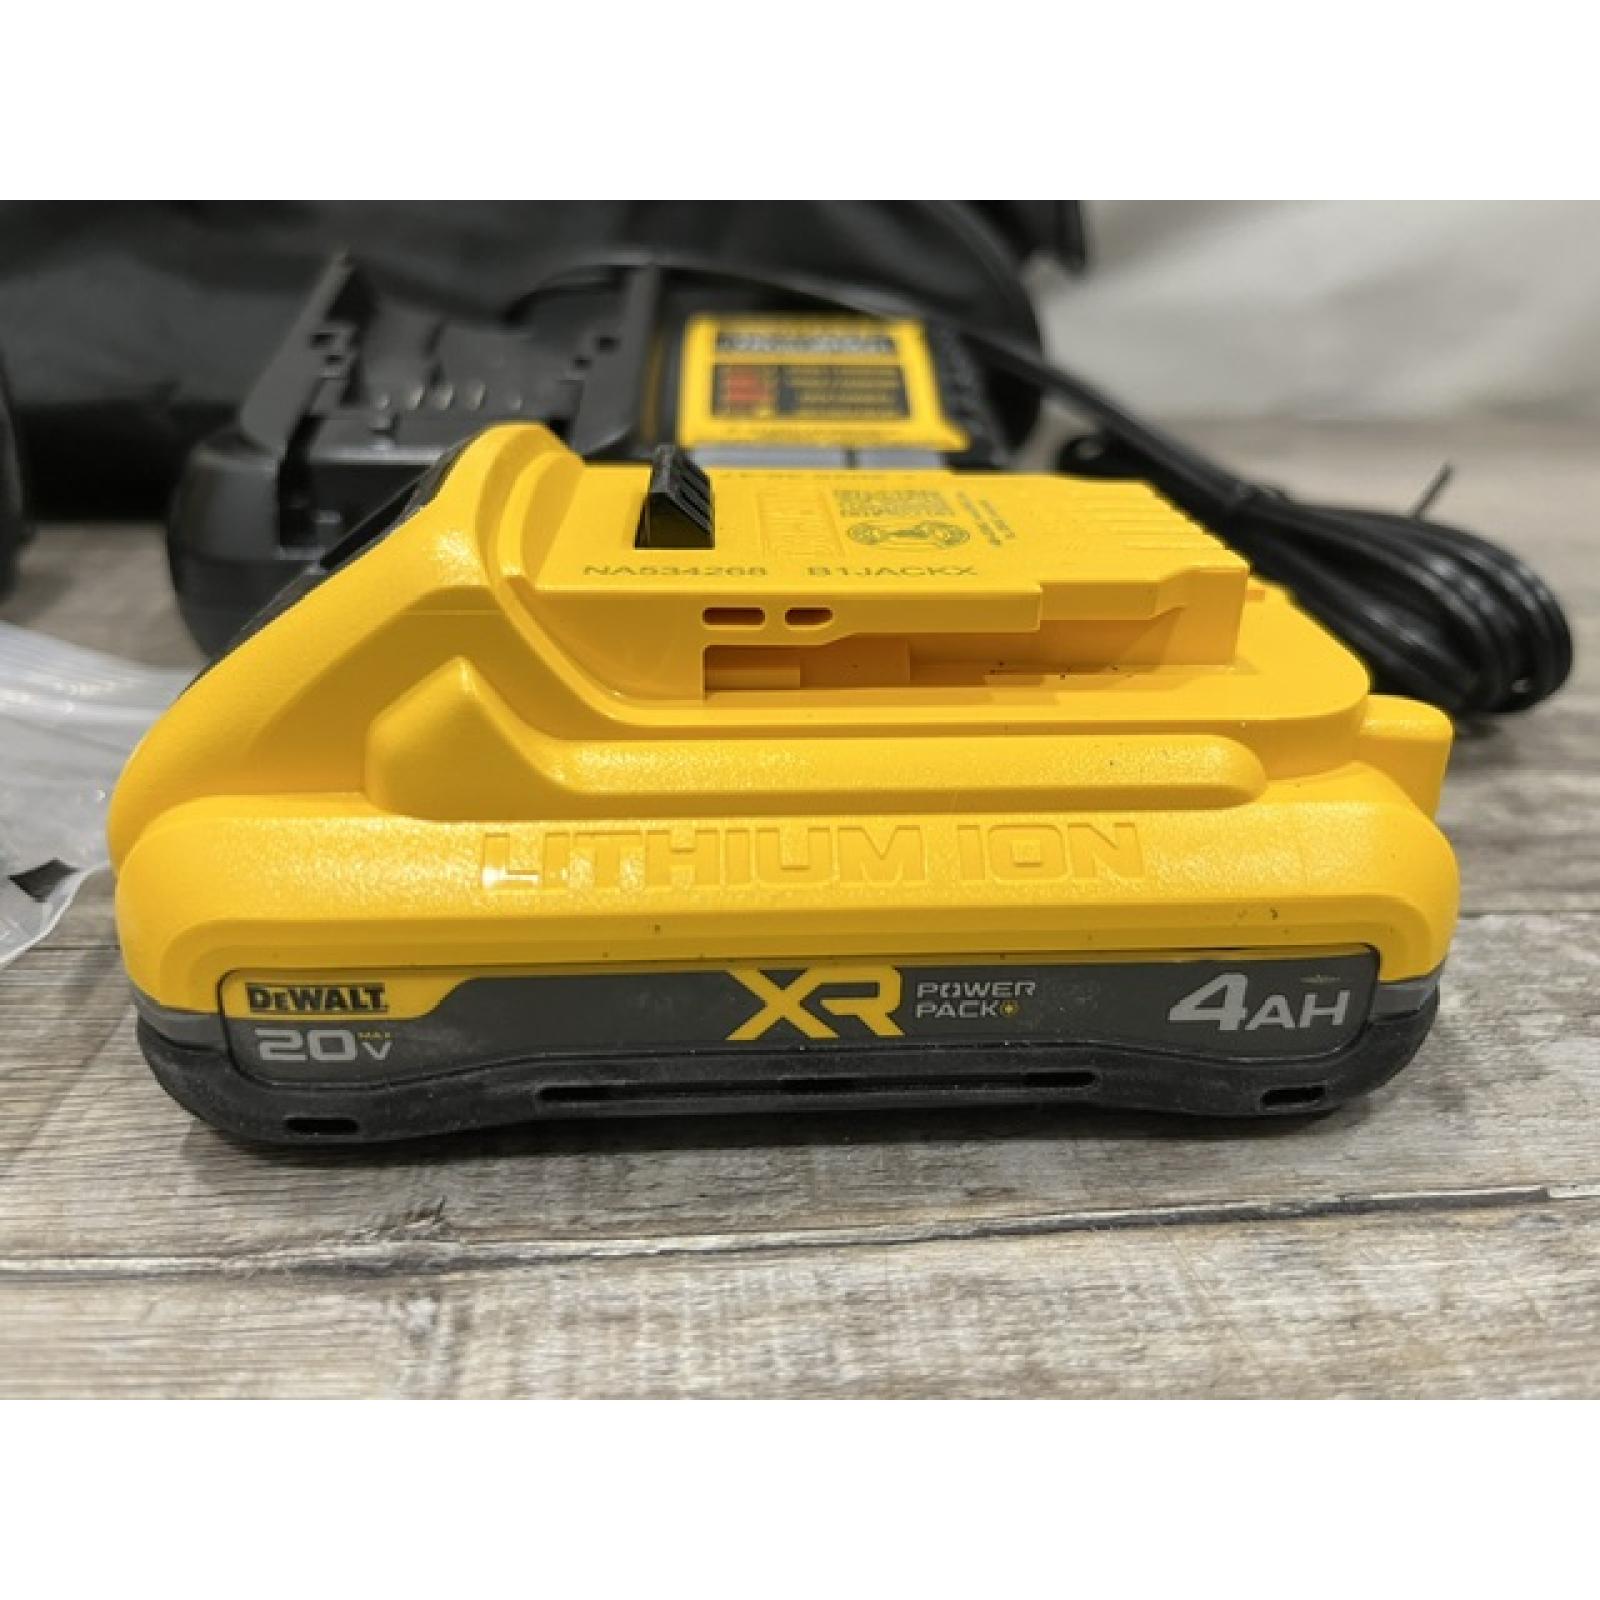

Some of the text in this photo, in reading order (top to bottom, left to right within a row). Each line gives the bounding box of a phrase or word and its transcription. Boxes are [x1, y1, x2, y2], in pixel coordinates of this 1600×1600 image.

[481, 821, 1144, 896] LITHIUM ION
[725, 965, 906, 1041] XR
[915, 999, 1000, 1019] PACK
[916, 980, 1036, 999] POWER
[1167, 972, 1351, 1031] 4AH
